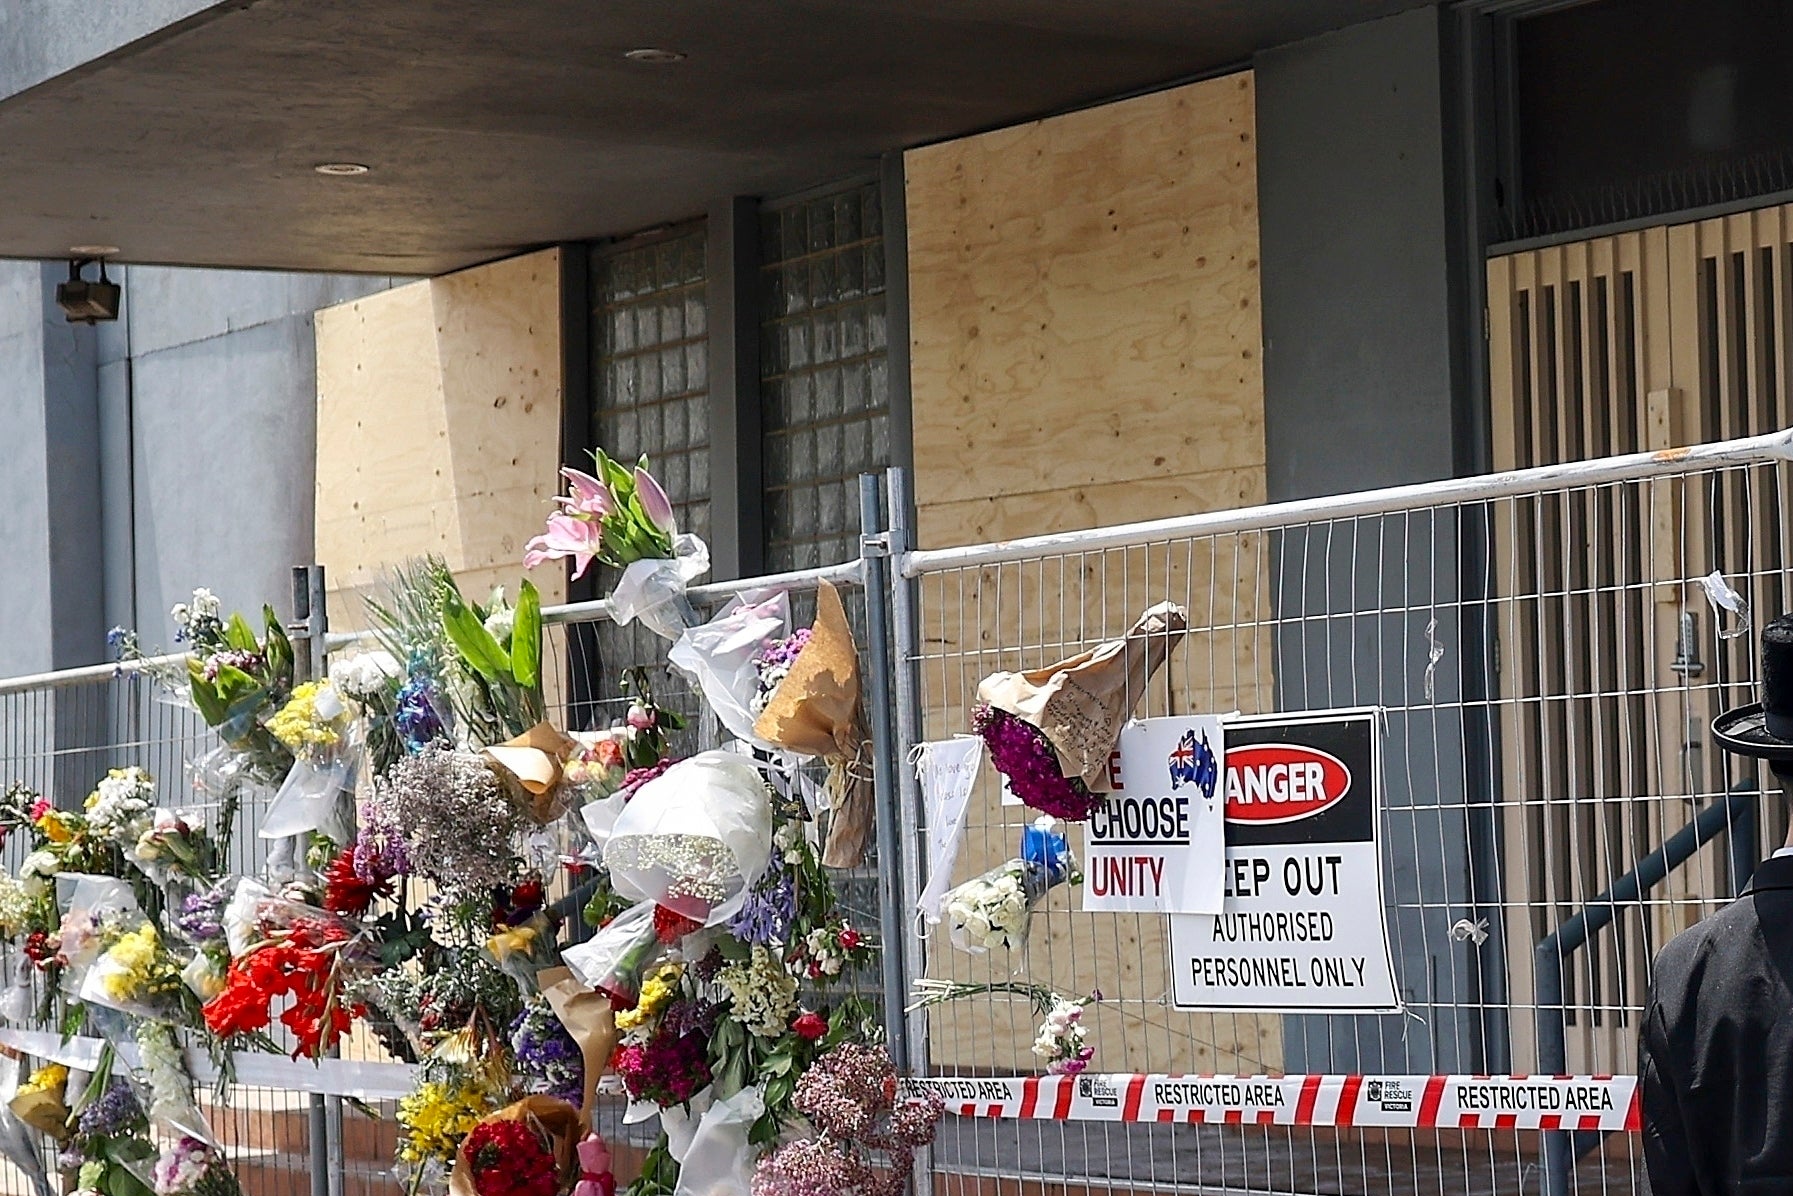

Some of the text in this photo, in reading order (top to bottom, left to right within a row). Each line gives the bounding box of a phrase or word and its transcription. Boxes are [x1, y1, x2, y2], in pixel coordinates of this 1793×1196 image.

[1225, 761, 1327, 804] ANGER
[1091, 797, 1190, 839] CHOOSE
[1091, 856, 1165, 897] UNITY
[1224, 856, 1342, 897] EP OUT
[1212, 912, 1334, 942] AUTHORISED
[1191, 957, 1365, 988] PERSONNEL ONLY
[977, 1080, 1013, 1101] AREA
[1155, 1083, 1285, 1107] RESTRICTED AREA
[1384, 1081, 1401, 1090] FIRE
[1384, 1090, 1413, 1100] RESCUE
[1457, 1086, 1614, 1111] RESTRICTED AREA
